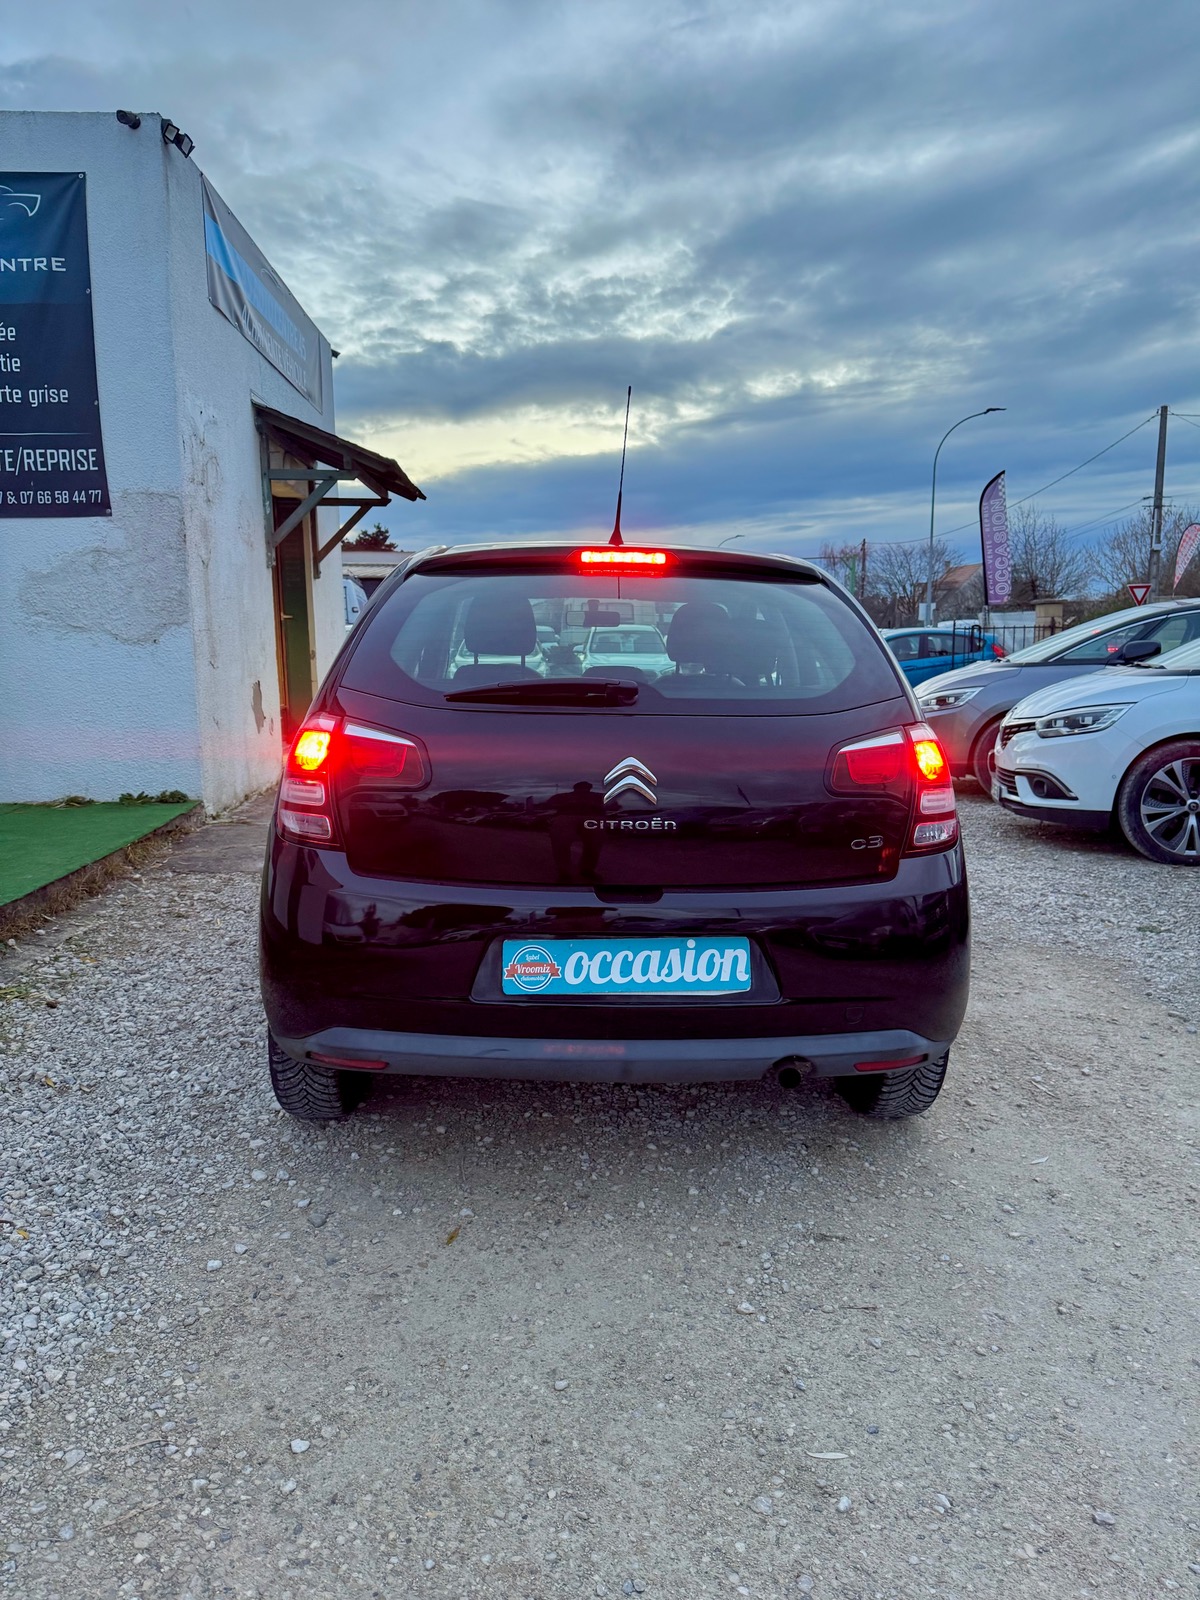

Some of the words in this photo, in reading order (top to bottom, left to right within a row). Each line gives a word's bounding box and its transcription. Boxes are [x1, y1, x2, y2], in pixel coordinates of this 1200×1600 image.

[28, 384, 69, 407] grise
[6, 491, 18, 504] &
[20, 491, 33, 504] 07
[37, 491, 52, 504] 66
[54, 490, 69, 504] 58
[72, 490, 86, 504] 44
[88, 490, 102, 503] 77
[990, 498, 1010, 595] OCCASION
[850, 835, 884, 850] C3
[514, 964, 551, 974] Vroomiz
[563, 938, 750, 985] occasion
